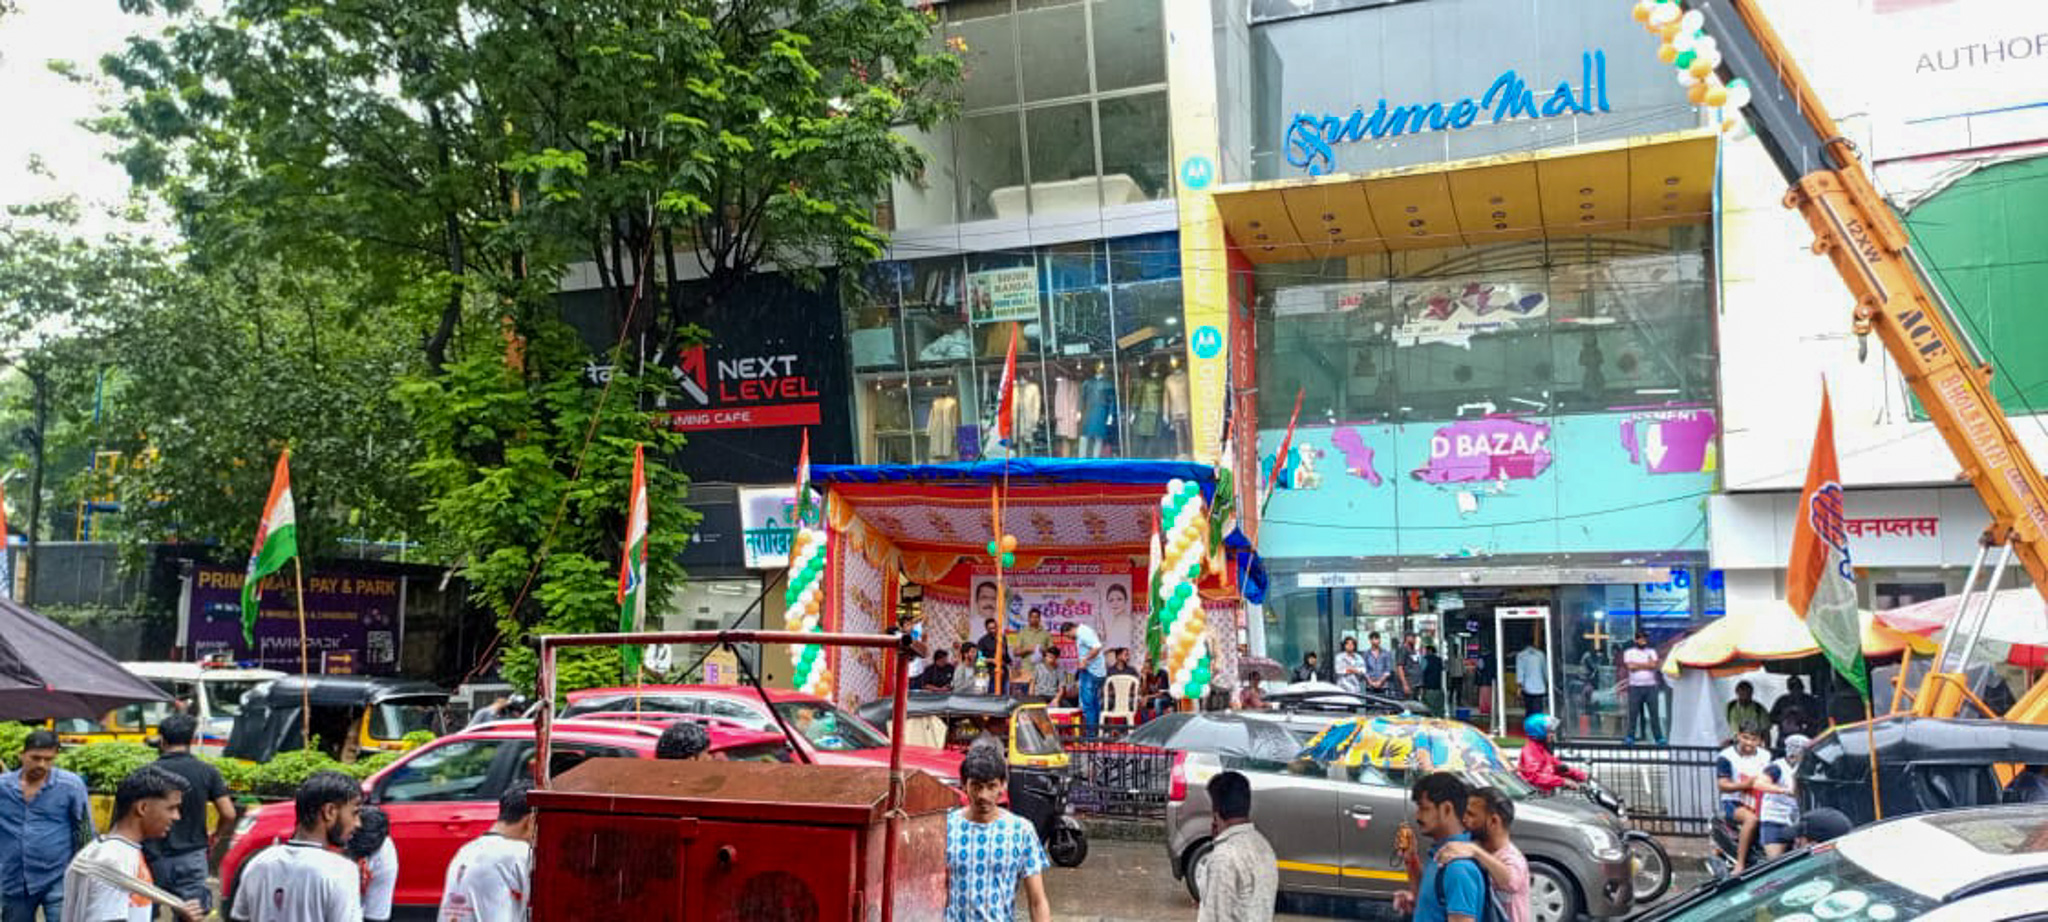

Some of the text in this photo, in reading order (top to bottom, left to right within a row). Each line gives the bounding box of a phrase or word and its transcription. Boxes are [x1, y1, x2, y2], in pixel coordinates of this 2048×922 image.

[1482, 48, 1610, 123] Mall
[1846, 218, 1882, 264] 12XW
[1897, 308, 1948, 364] ACE
[718, 354, 799, 380] NEXT
[719, 376, 820, 402] LEVEL
[714, 411, 751, 424] CAFE
[199, 570, 245, 588] PRIM
[310, 577, 337, 594] PAY
[341, 580, 352, 594] &
[356, 580, 396, 596] PARK
